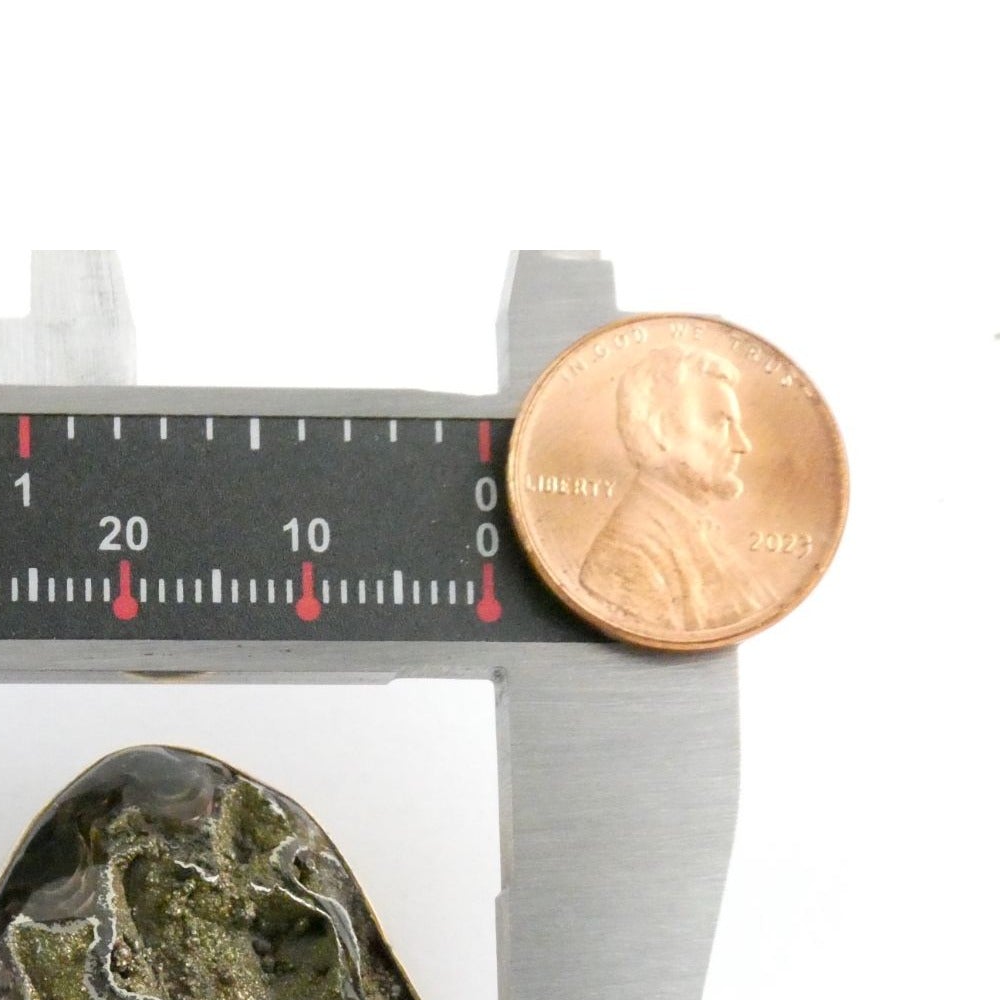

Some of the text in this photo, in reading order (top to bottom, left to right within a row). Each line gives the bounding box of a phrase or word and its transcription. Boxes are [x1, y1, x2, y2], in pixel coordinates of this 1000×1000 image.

[668, 320, 704, 340] WE
[13, 470, 499, 513] 1 0
[525, 472, 616, 498] LIBERTY
[97, 514, 150, 553] 20
[281, 515, 332, 555] 10
[474, 521, 500, 559] 0
[749, 530, 812, 560] 2023
